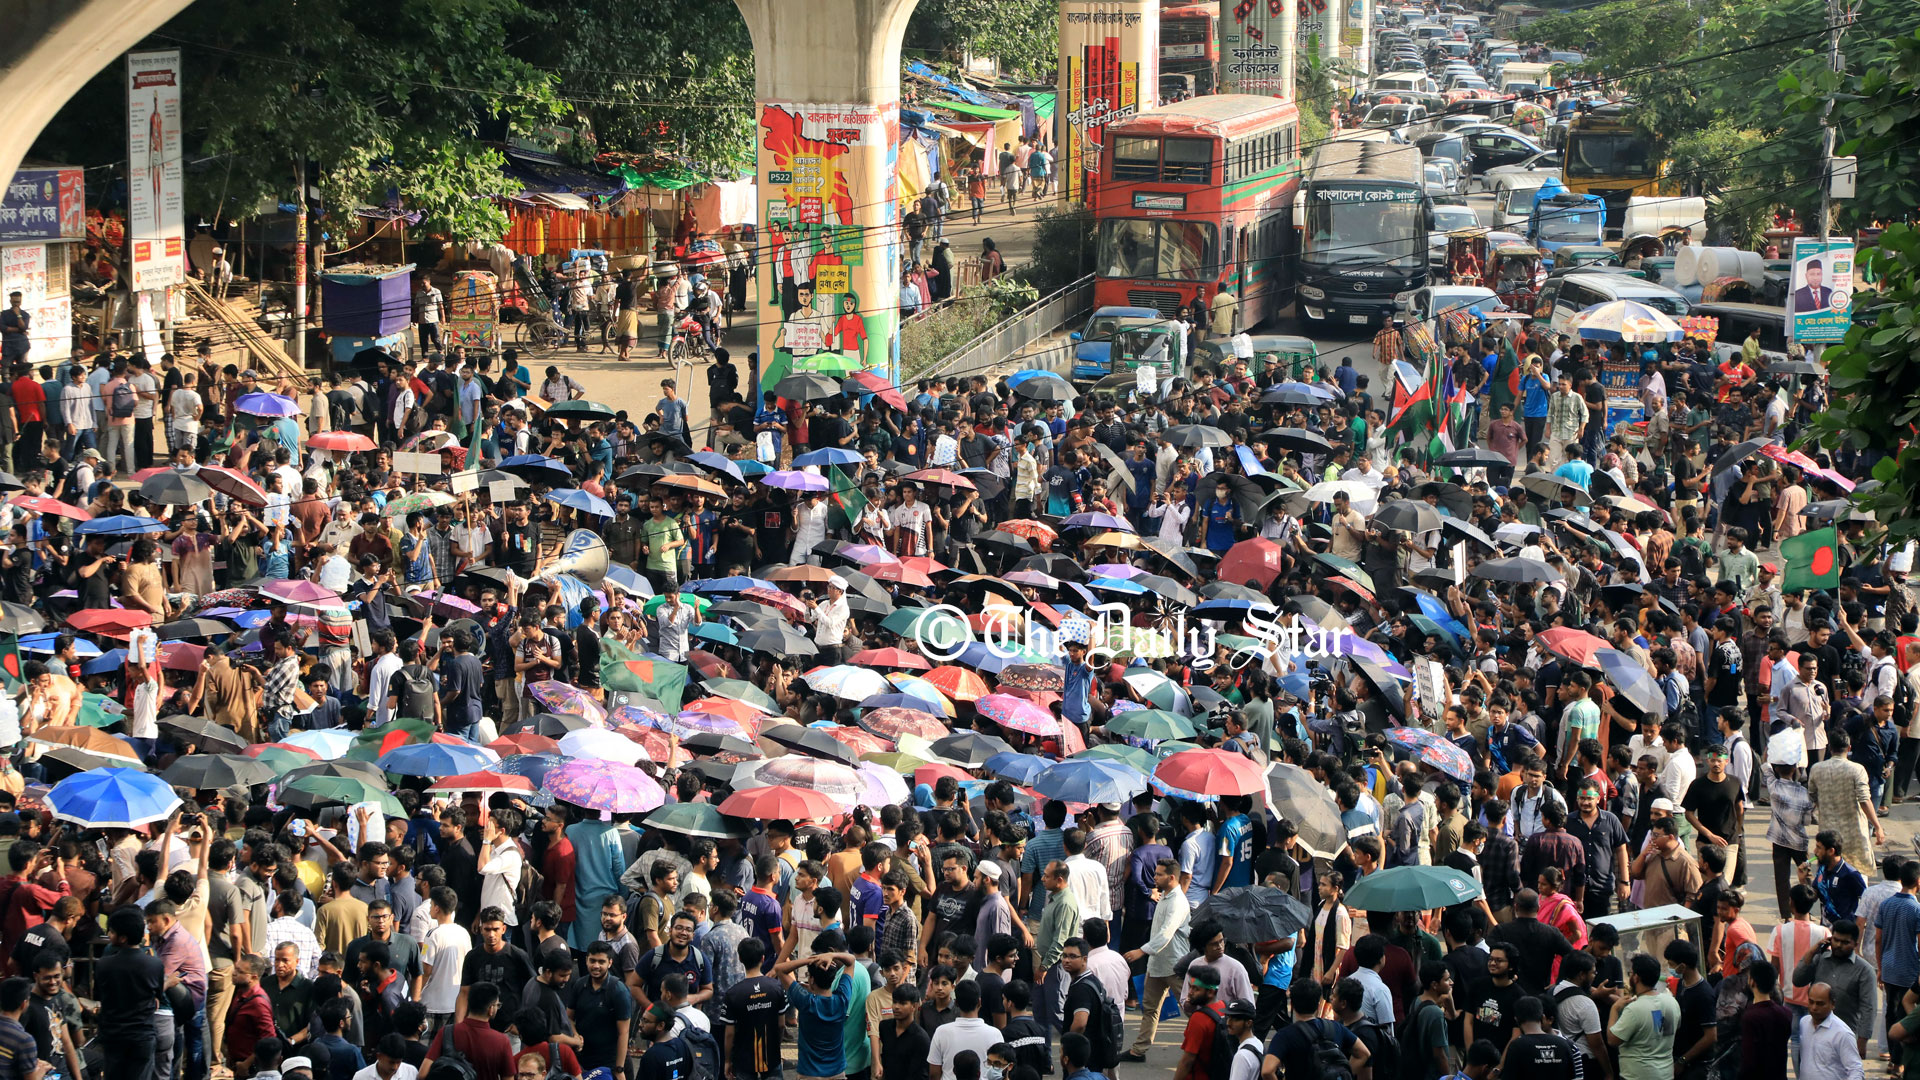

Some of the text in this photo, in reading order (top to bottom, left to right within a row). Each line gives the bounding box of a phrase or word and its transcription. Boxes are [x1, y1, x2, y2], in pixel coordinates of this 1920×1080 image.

[1231, 44, 1279, 60] ফ্যাসিস্ট
[1228, 62, 1279, 75] রেজিমের
[1239, 78, 1283, 91] আমলনামা
[808, 112, 840, 123] বাংলাদেশ
[827, 128, 861, 144] যুবদল
[770, 174, 791, 186] P522
[1316, 189, 1419, 203] বাংলাদেশ কোস্ট গার্ড
[19, 202, 41, 227] পুলিশ
[42, 206, 57, 223] বক্স
